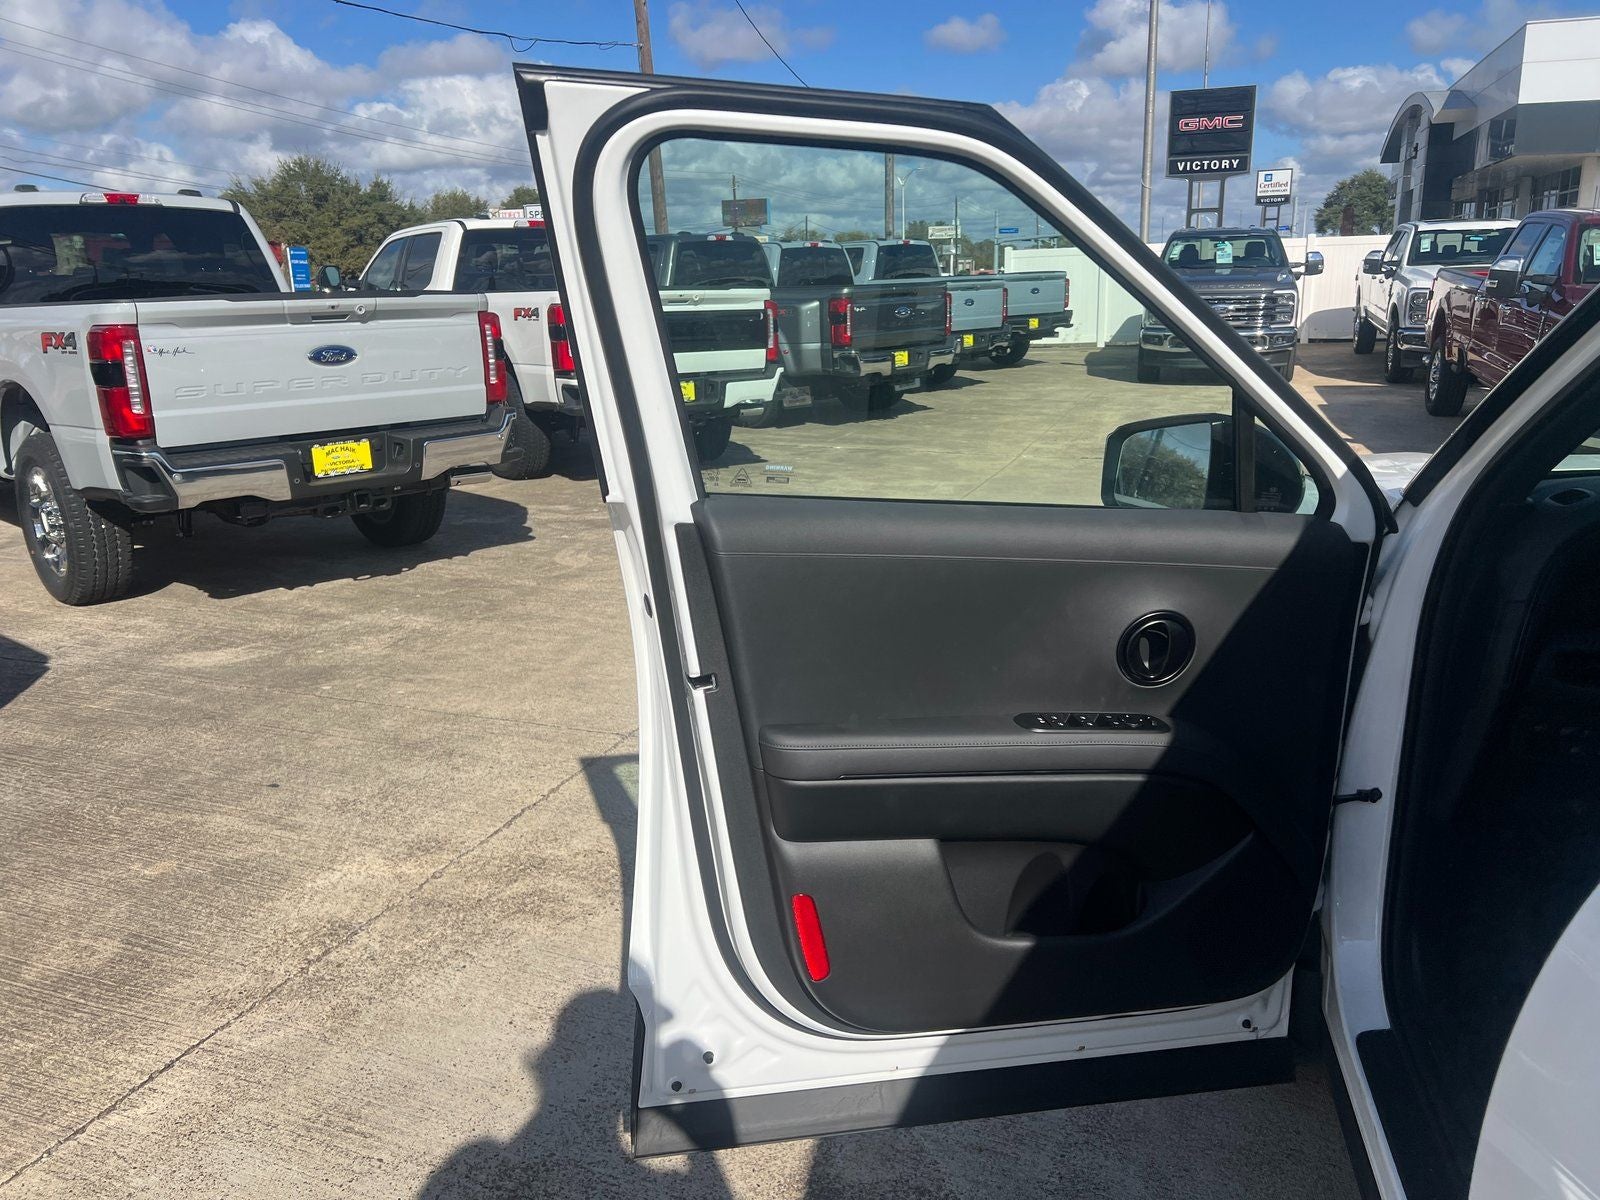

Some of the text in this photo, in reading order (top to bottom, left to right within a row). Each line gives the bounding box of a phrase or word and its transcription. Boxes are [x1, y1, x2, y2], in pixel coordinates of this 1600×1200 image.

[1179, 115, 1244, 131] GMC
[1177, 159, 1240, 172] VICTORY
[1259, 181, 1289, 189] Certified
[514, 307, 540, 320] FX4
[41, 331, 77, 354] FX4
[319, 348, 346, 362] Ford
[174, 366, 470, 400] SUPER DUTY
[325, 446, 339, 457] MAC
